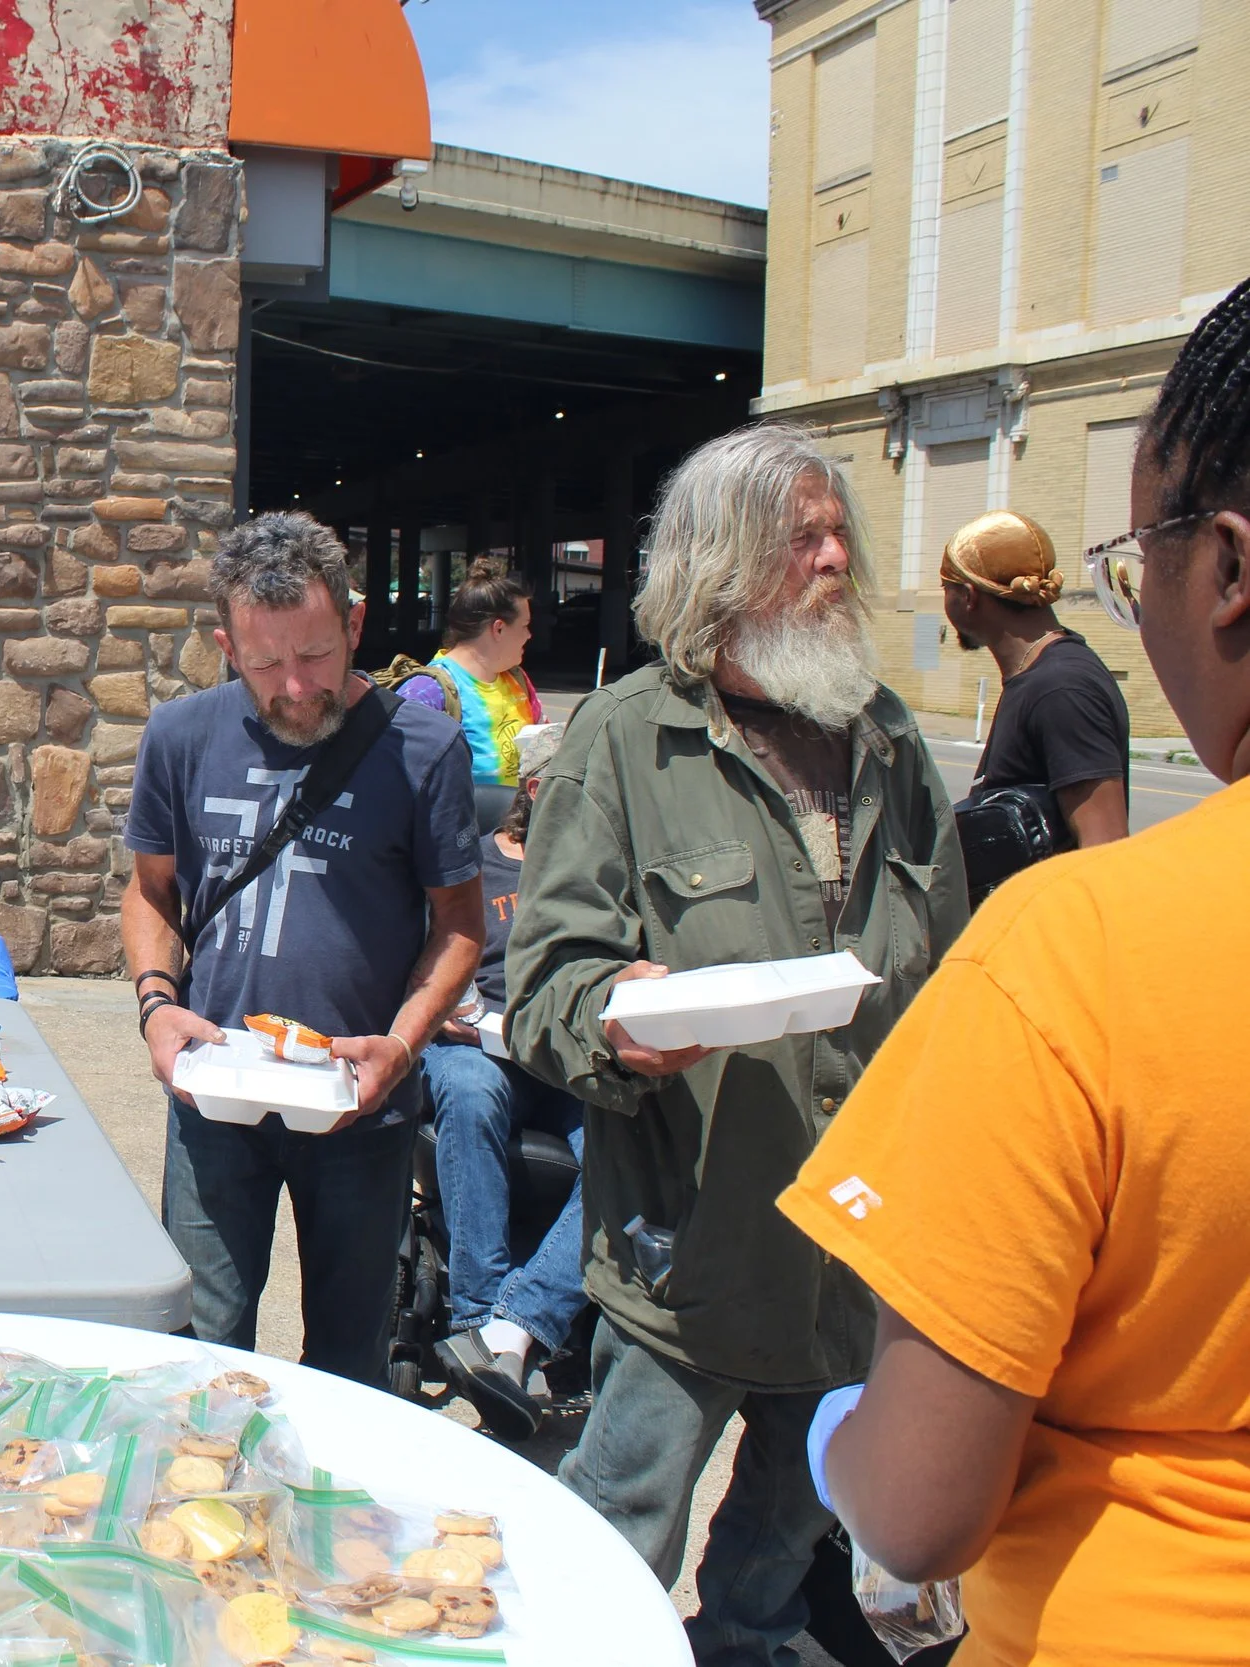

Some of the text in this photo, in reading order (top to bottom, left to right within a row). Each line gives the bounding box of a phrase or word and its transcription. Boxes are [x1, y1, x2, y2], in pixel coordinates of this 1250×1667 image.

[302, 825, 354, 851] ROCK
[238, 930, 251, 942] 20
[238, 942, 248, 953] 17
